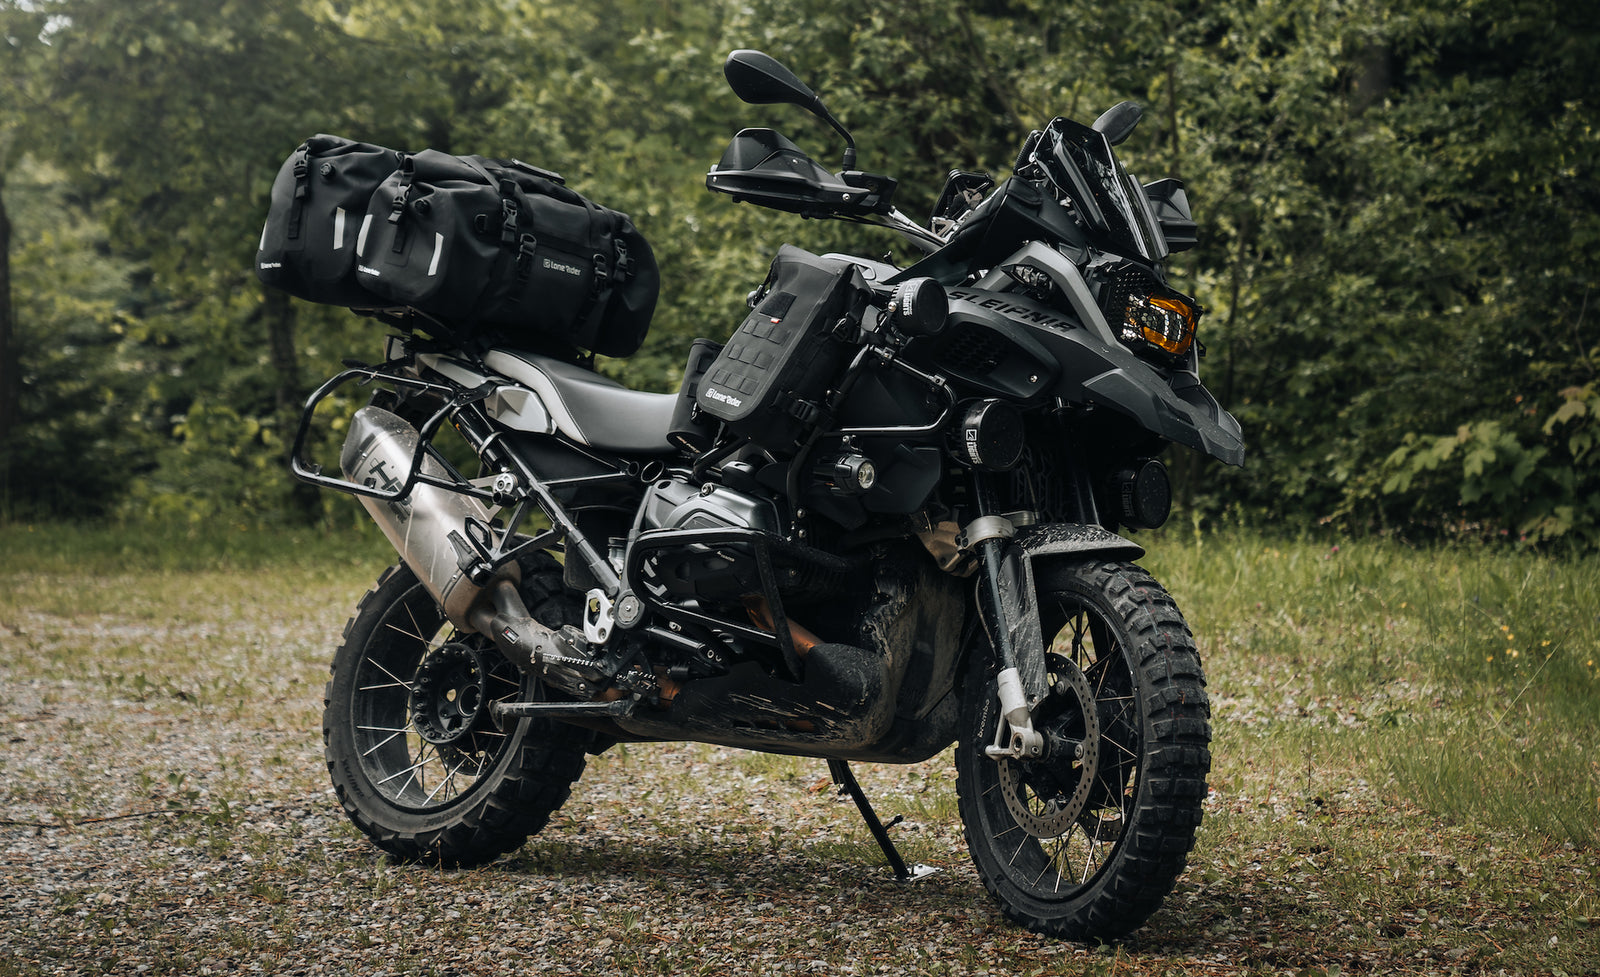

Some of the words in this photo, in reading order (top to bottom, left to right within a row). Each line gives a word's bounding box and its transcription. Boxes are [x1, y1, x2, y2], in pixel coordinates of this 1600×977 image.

[551, 261, 565, 272] Lone
[948, 291, 1077, 333] SLEIPNIR
[712, 391, 727, 403] Lone
[977, 699, 990, 738] brembo
